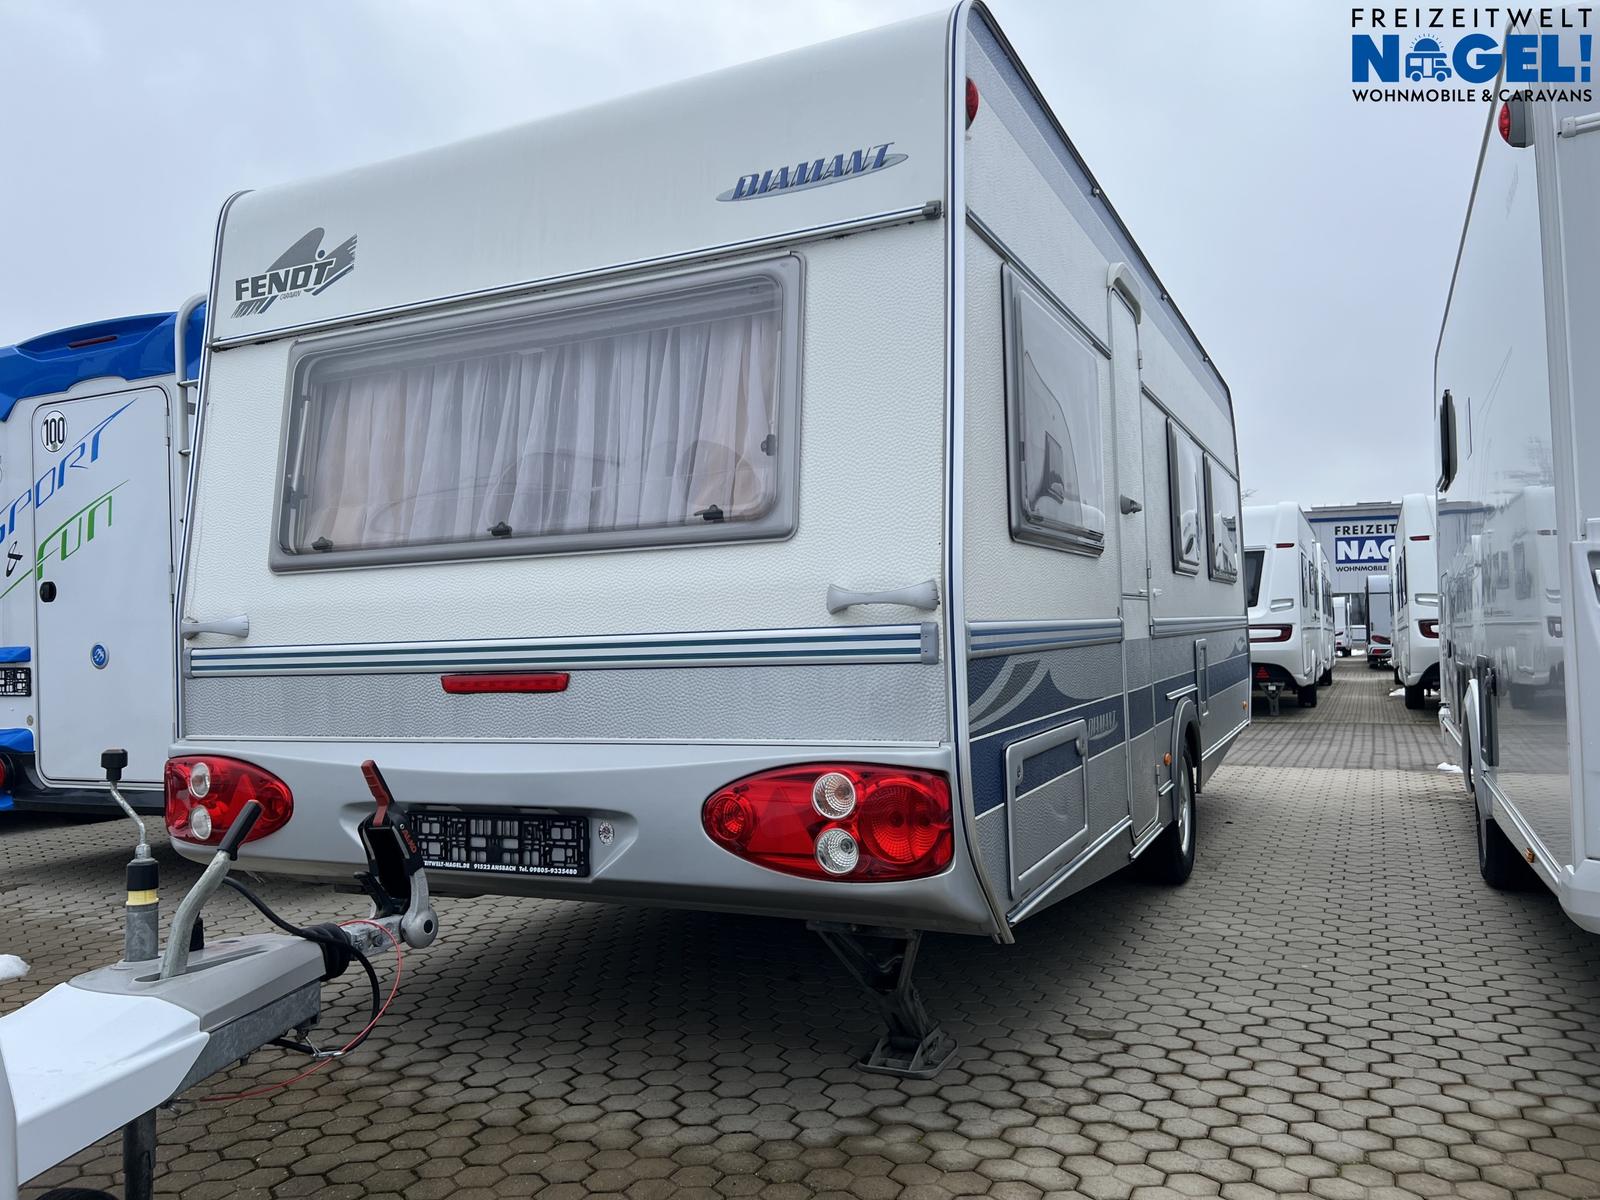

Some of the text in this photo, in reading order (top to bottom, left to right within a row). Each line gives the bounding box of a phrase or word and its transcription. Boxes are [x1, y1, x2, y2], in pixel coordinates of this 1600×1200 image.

[731, 142, 896, 200] DIAMANT
[235, 259, 335, 301] FENDT
[43, 416, 65, 446] 100
[1335, 524, 1397, 535] FREIZEIT
